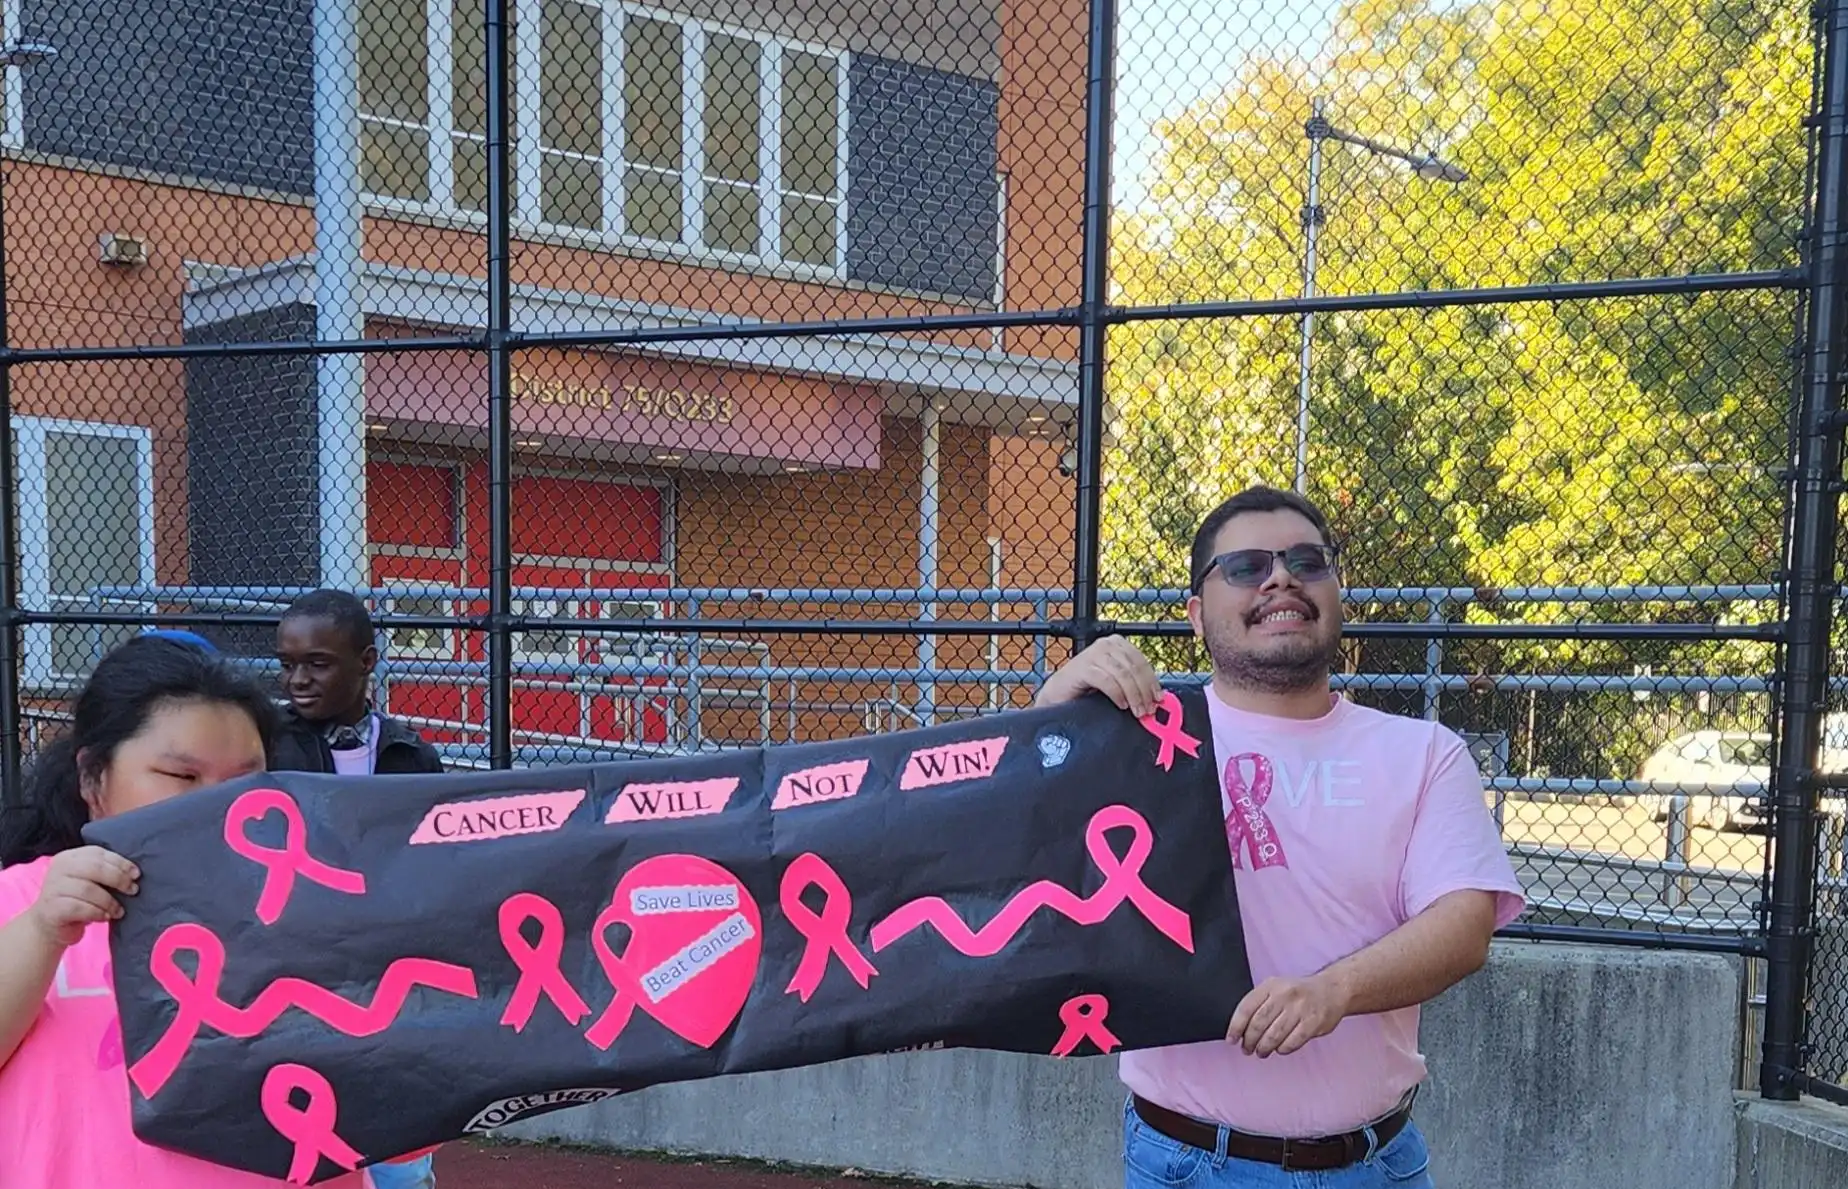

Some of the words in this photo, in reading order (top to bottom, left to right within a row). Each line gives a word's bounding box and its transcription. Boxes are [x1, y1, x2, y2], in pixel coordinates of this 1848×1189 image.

[510, 372, 611, 411] District
[637, 894, 681, 911] Save
[687, 891, 734, 908] Lives
[646, 958, 689, 993] Beat
[688, 918, 746, 963] Cancer
[469, 1090, 609, 1130] TOGETHER
